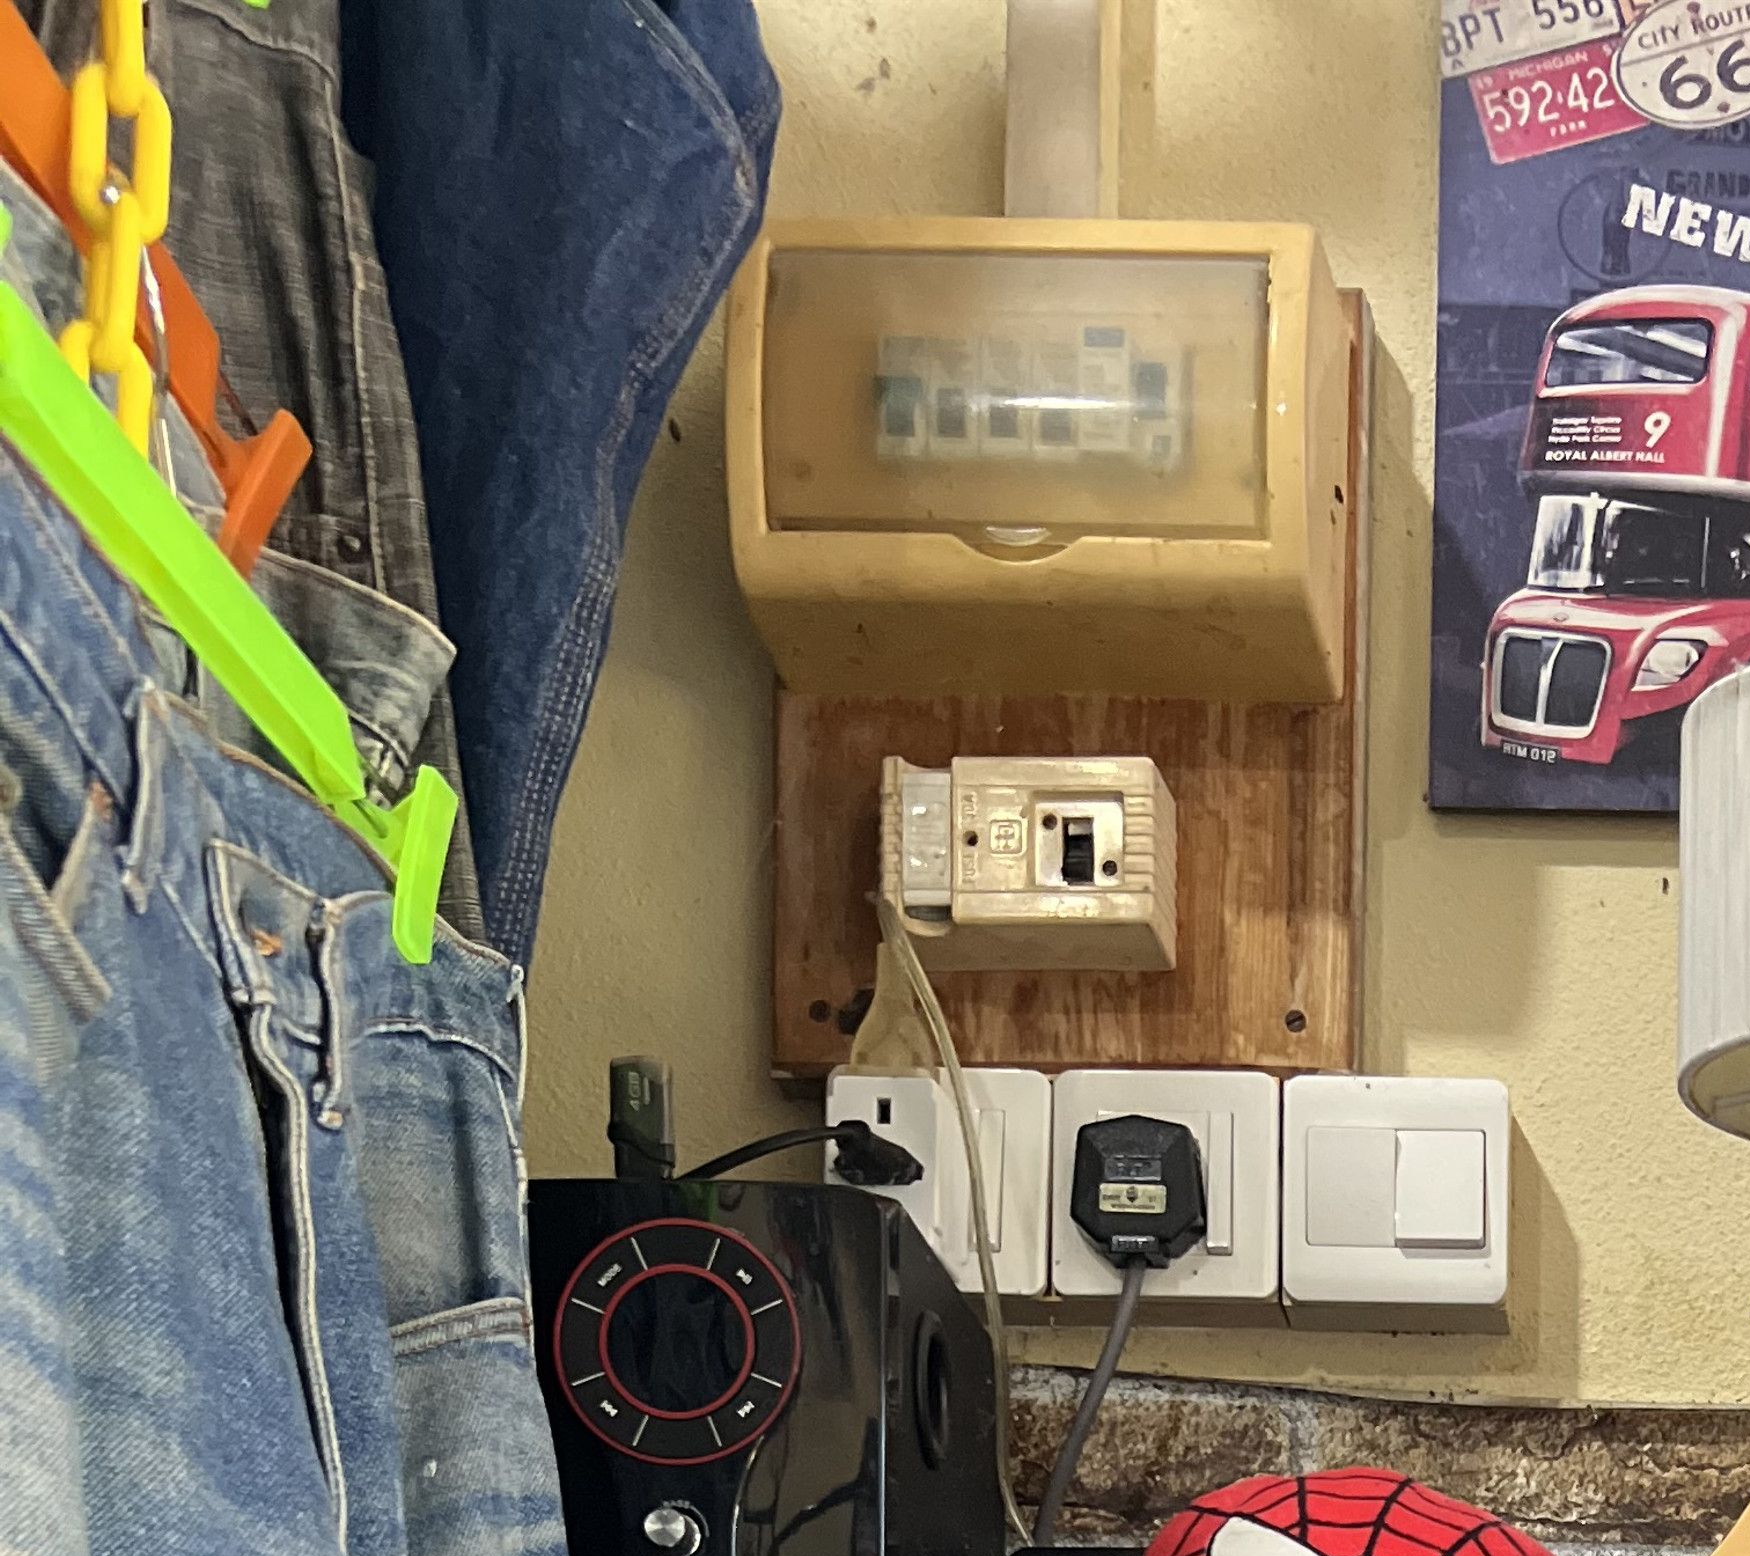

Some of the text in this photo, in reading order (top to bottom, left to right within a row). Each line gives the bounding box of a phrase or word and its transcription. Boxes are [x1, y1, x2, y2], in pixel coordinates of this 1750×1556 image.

[1638, 23, 1680, 49] CITY
[1643, 410, 1672, 449] 9
[1545, 450, 1665, 464] ROYAL ALBERT HALL
[1530, 747, 1557, 764] 012
